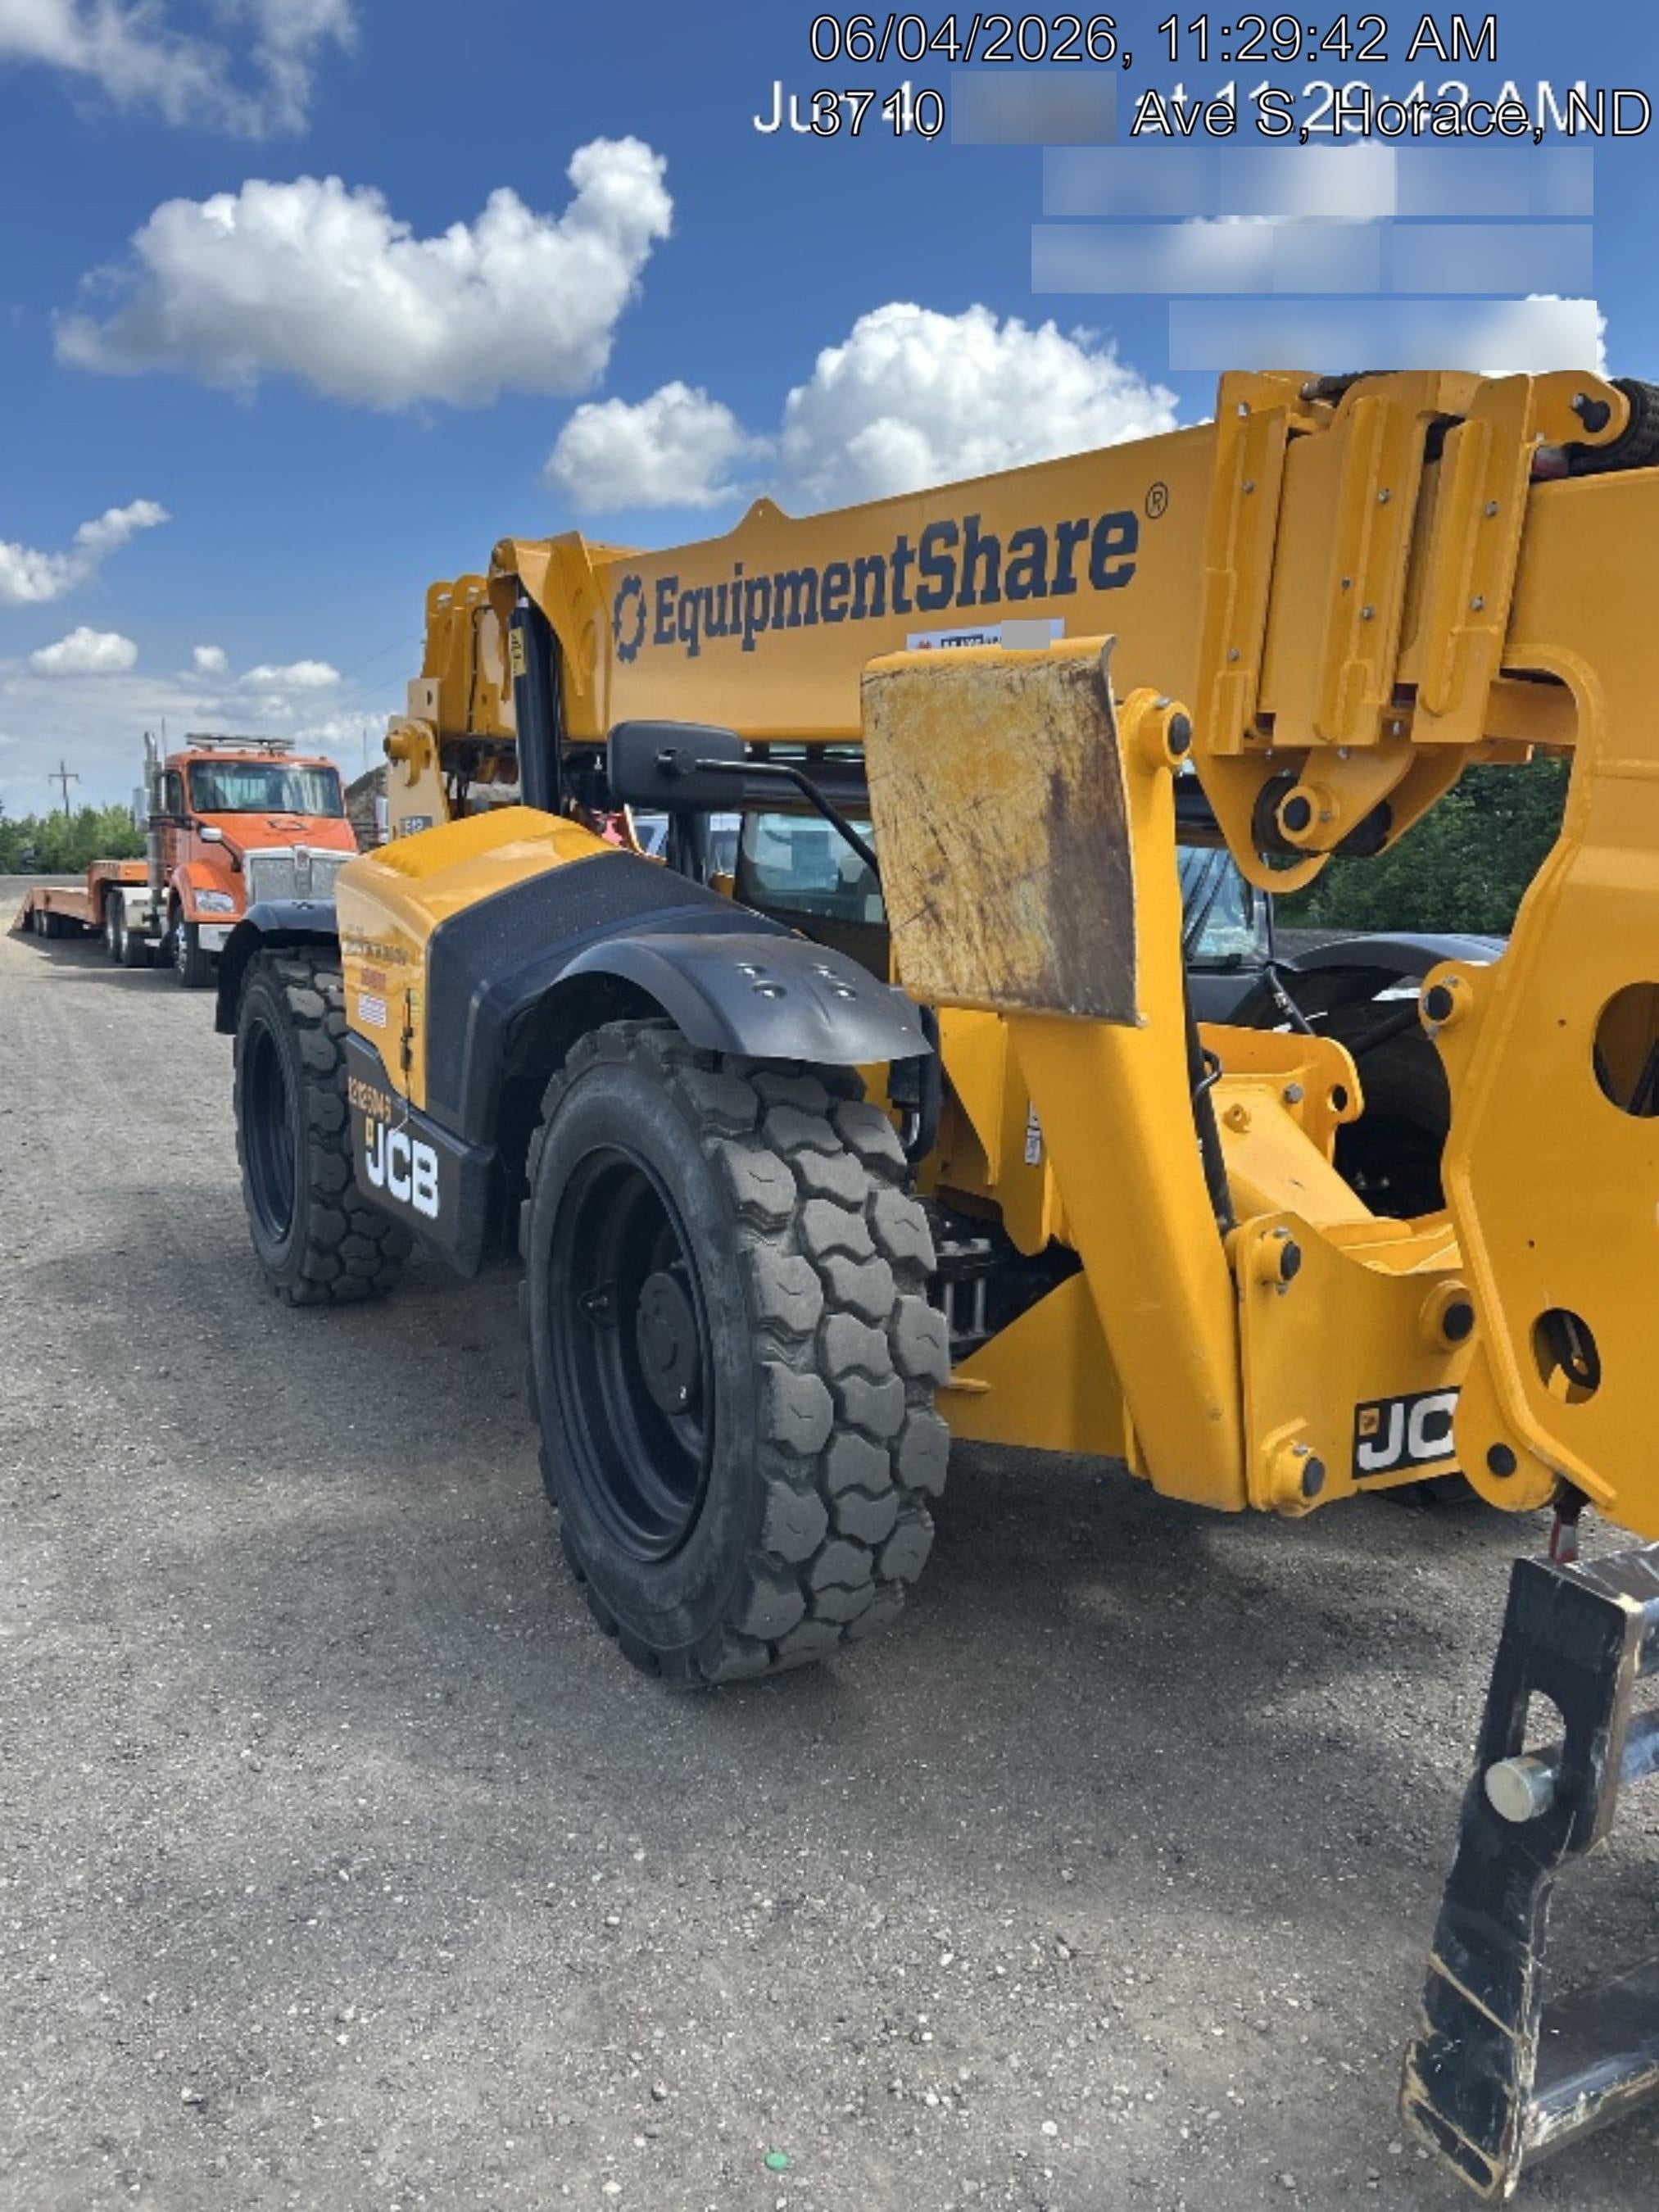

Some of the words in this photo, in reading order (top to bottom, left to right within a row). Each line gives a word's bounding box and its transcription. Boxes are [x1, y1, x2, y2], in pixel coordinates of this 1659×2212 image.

[653, 510, 1140, 658] EquipmentShare
[365, 1122, 439, 1220] JCB
[1357, 1393, 1459, 1471] JC
